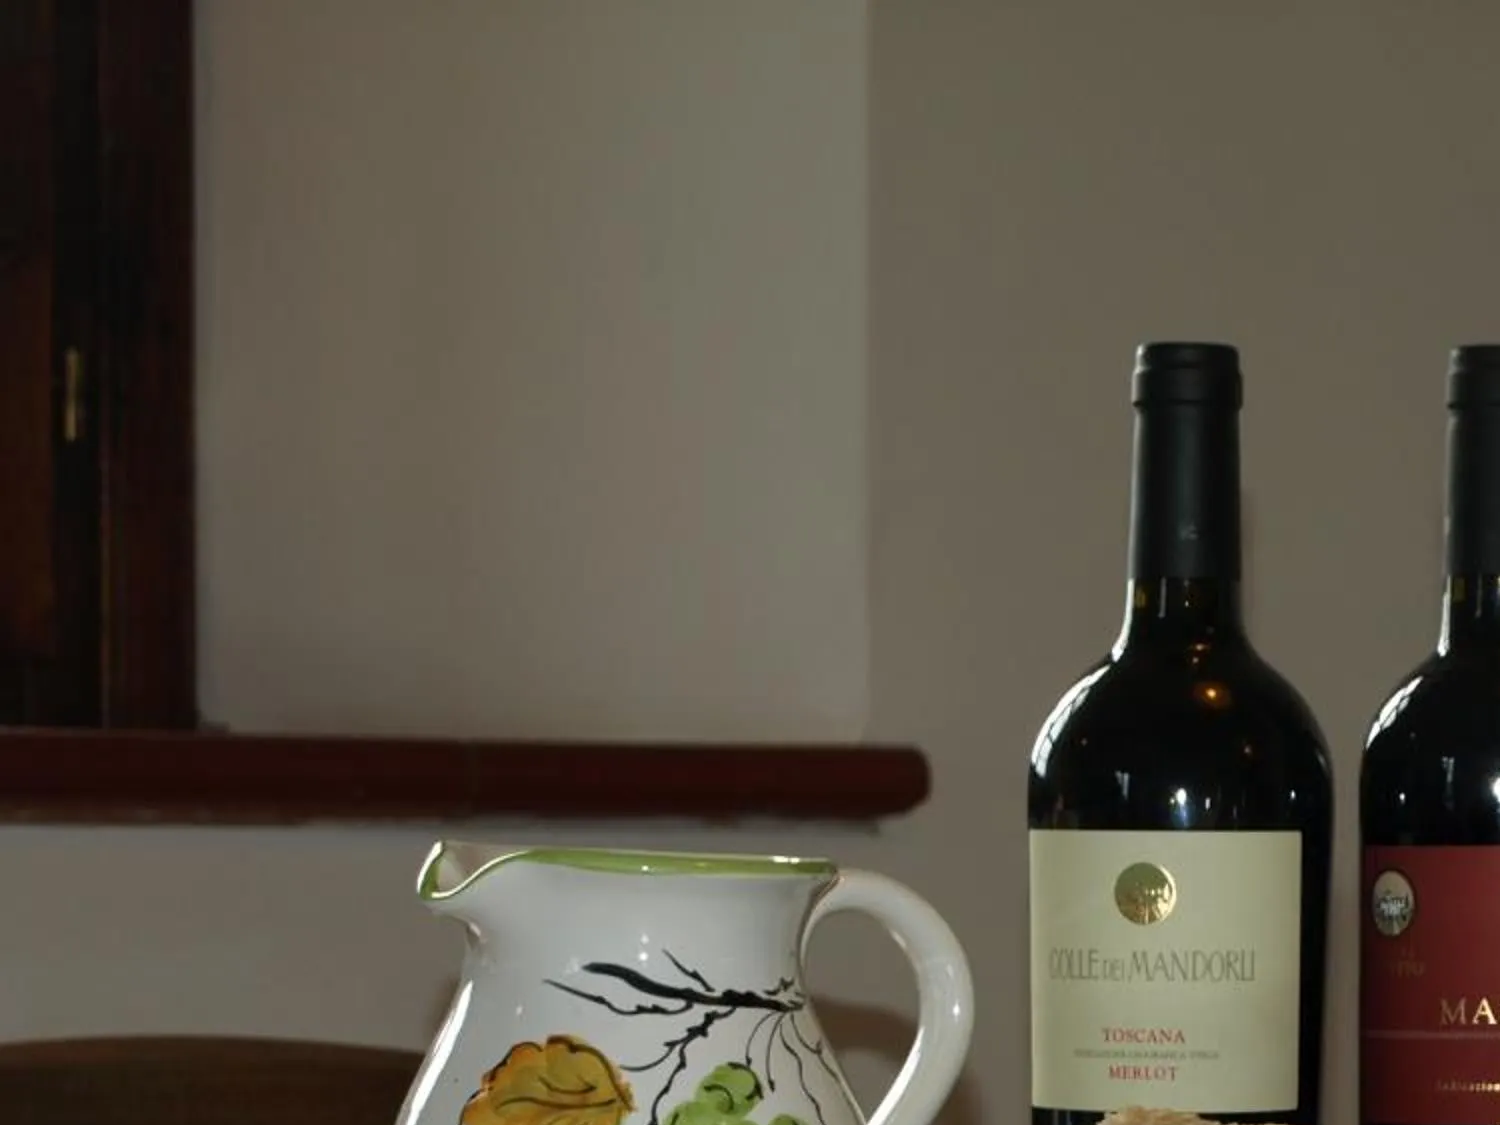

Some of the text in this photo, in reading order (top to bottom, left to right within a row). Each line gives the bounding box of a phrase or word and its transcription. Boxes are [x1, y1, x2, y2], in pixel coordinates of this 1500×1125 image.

[1049, 948, 1099, 981] COLLE
[1103, 1028, 1186, 1044] TOSCANA
[1109, 1065, 1177, 1081] MERLOT
